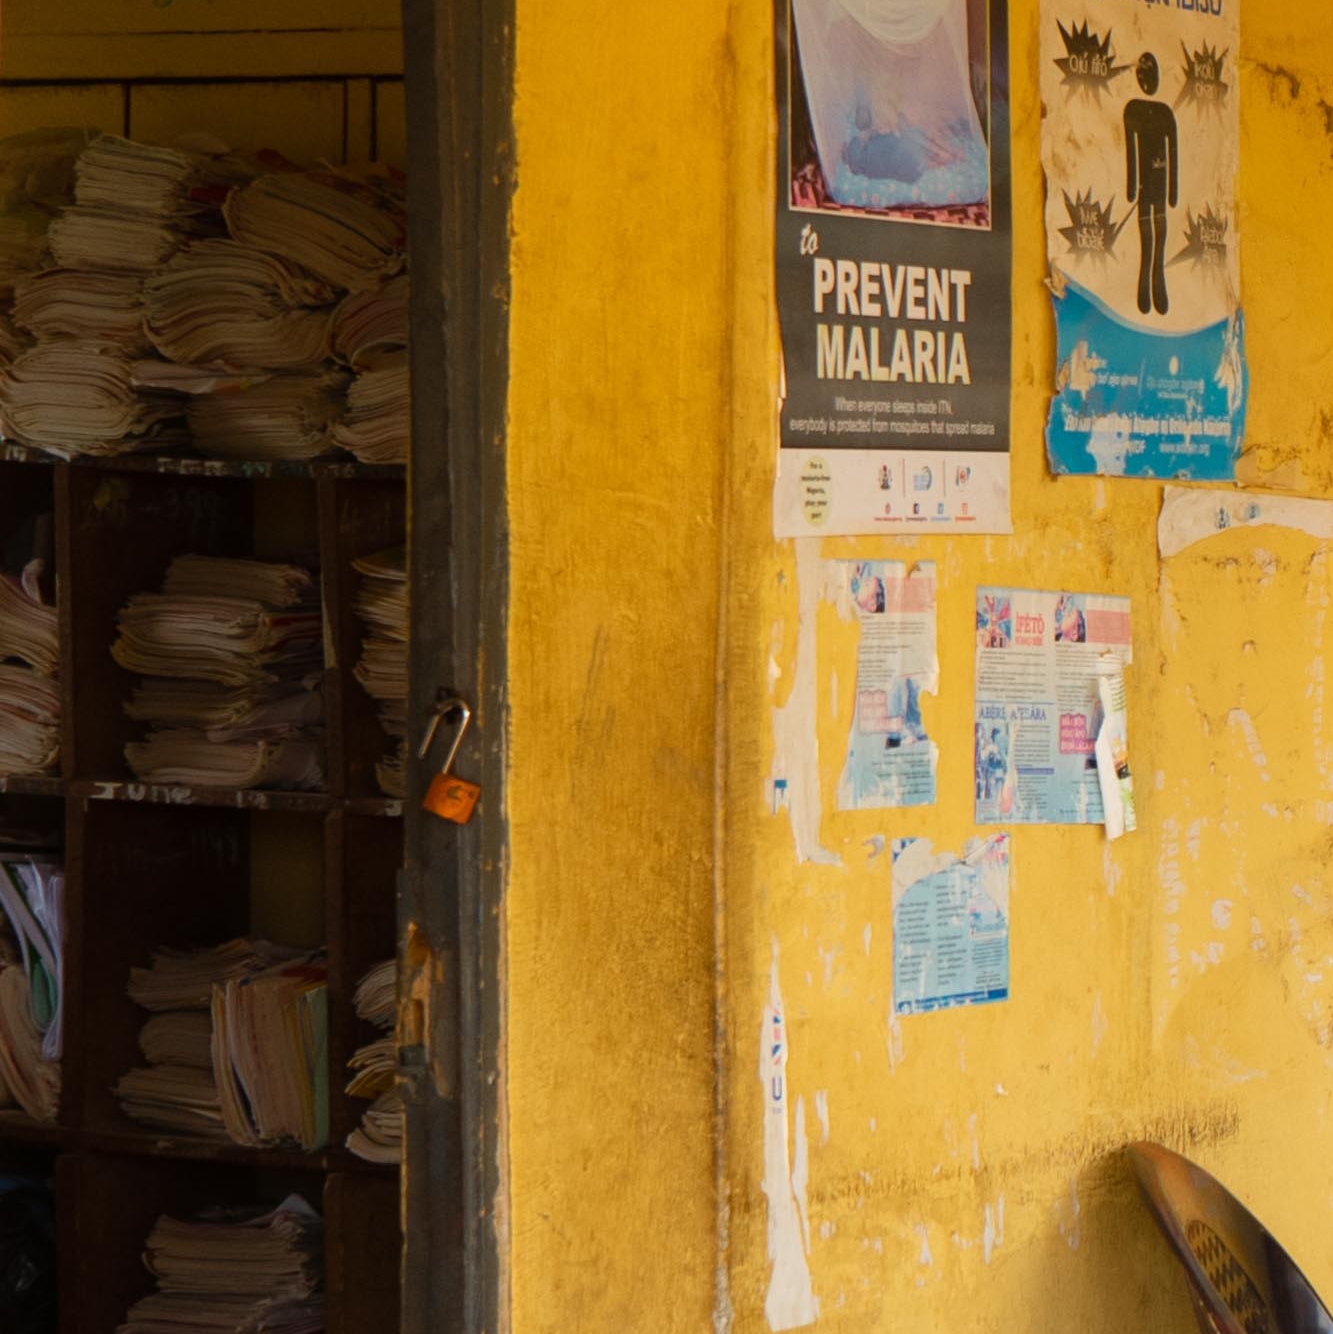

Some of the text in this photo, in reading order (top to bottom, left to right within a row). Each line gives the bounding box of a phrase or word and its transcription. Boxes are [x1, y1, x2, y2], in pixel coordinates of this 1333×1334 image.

[800, 224, 819, 255] to
[814, 257, 972, 322] PREVENT
[817, 324, 971, 385] MALARIA
